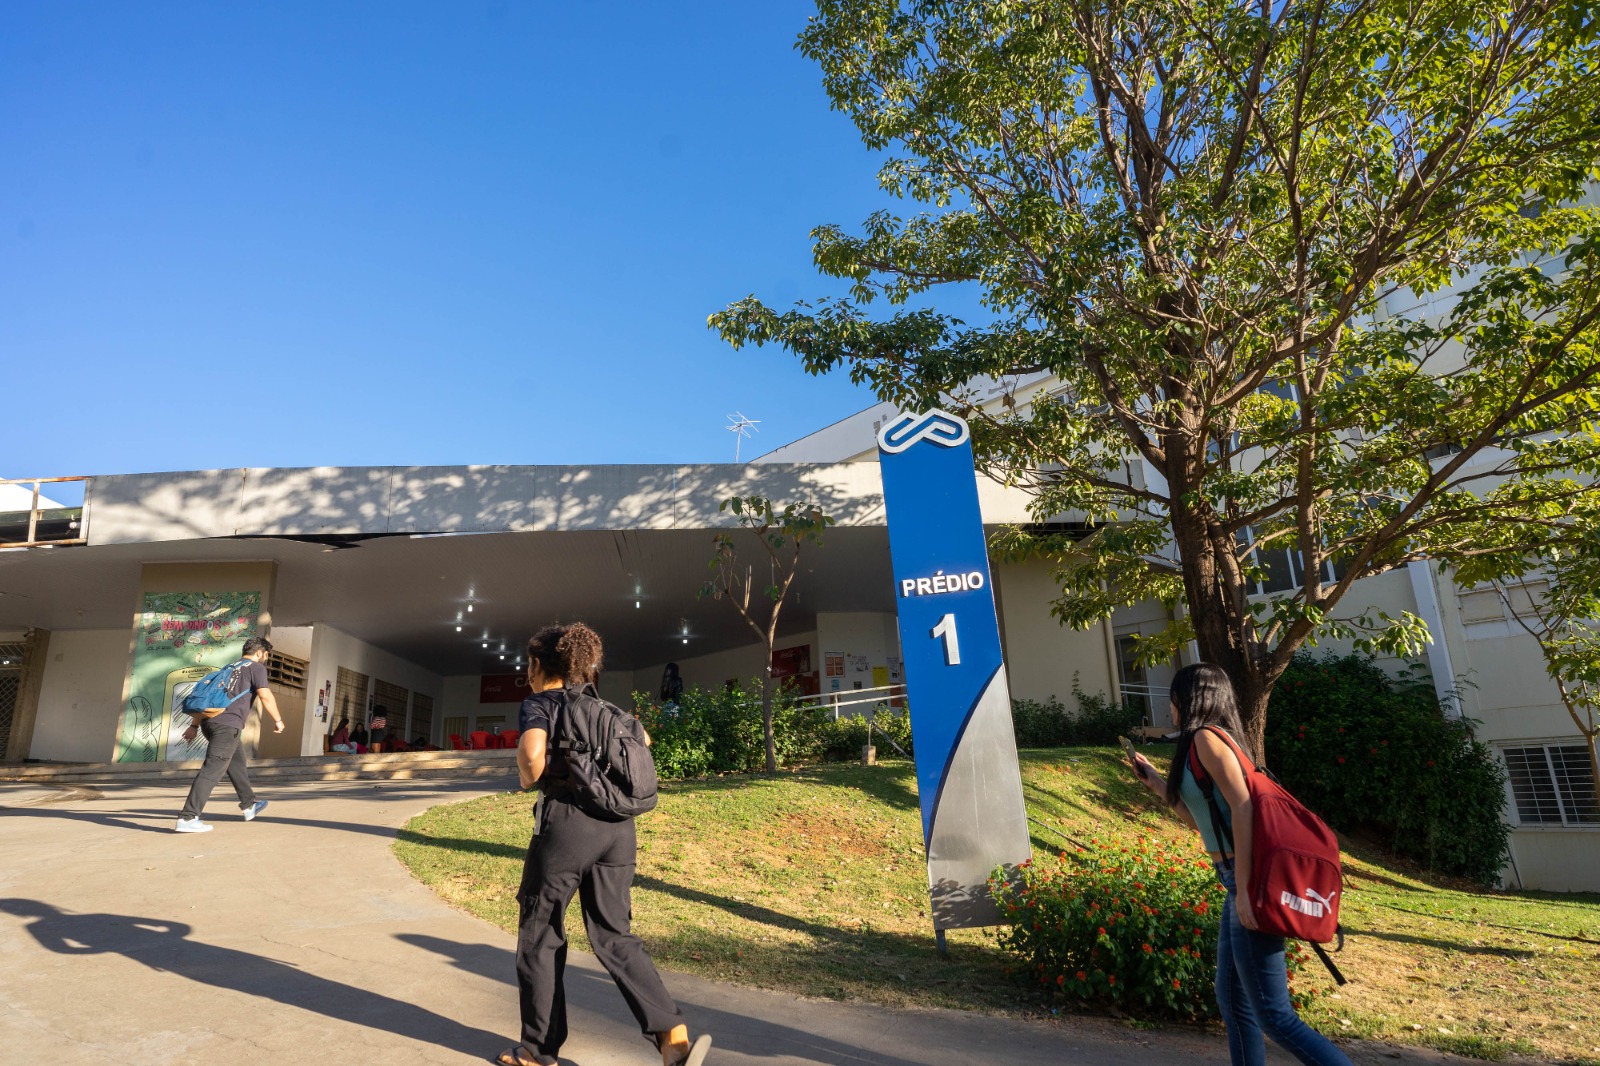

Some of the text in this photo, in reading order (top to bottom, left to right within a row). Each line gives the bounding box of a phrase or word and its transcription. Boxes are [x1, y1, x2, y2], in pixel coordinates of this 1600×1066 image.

[901, 570, 984, 597] PRÉDIO
[161, 620, 184, 631] BEM
[187, 620, 221, 631] VINDOS
[932, 613, 961, 665] 1
[1281, 891, 1323, 918] PUMA
